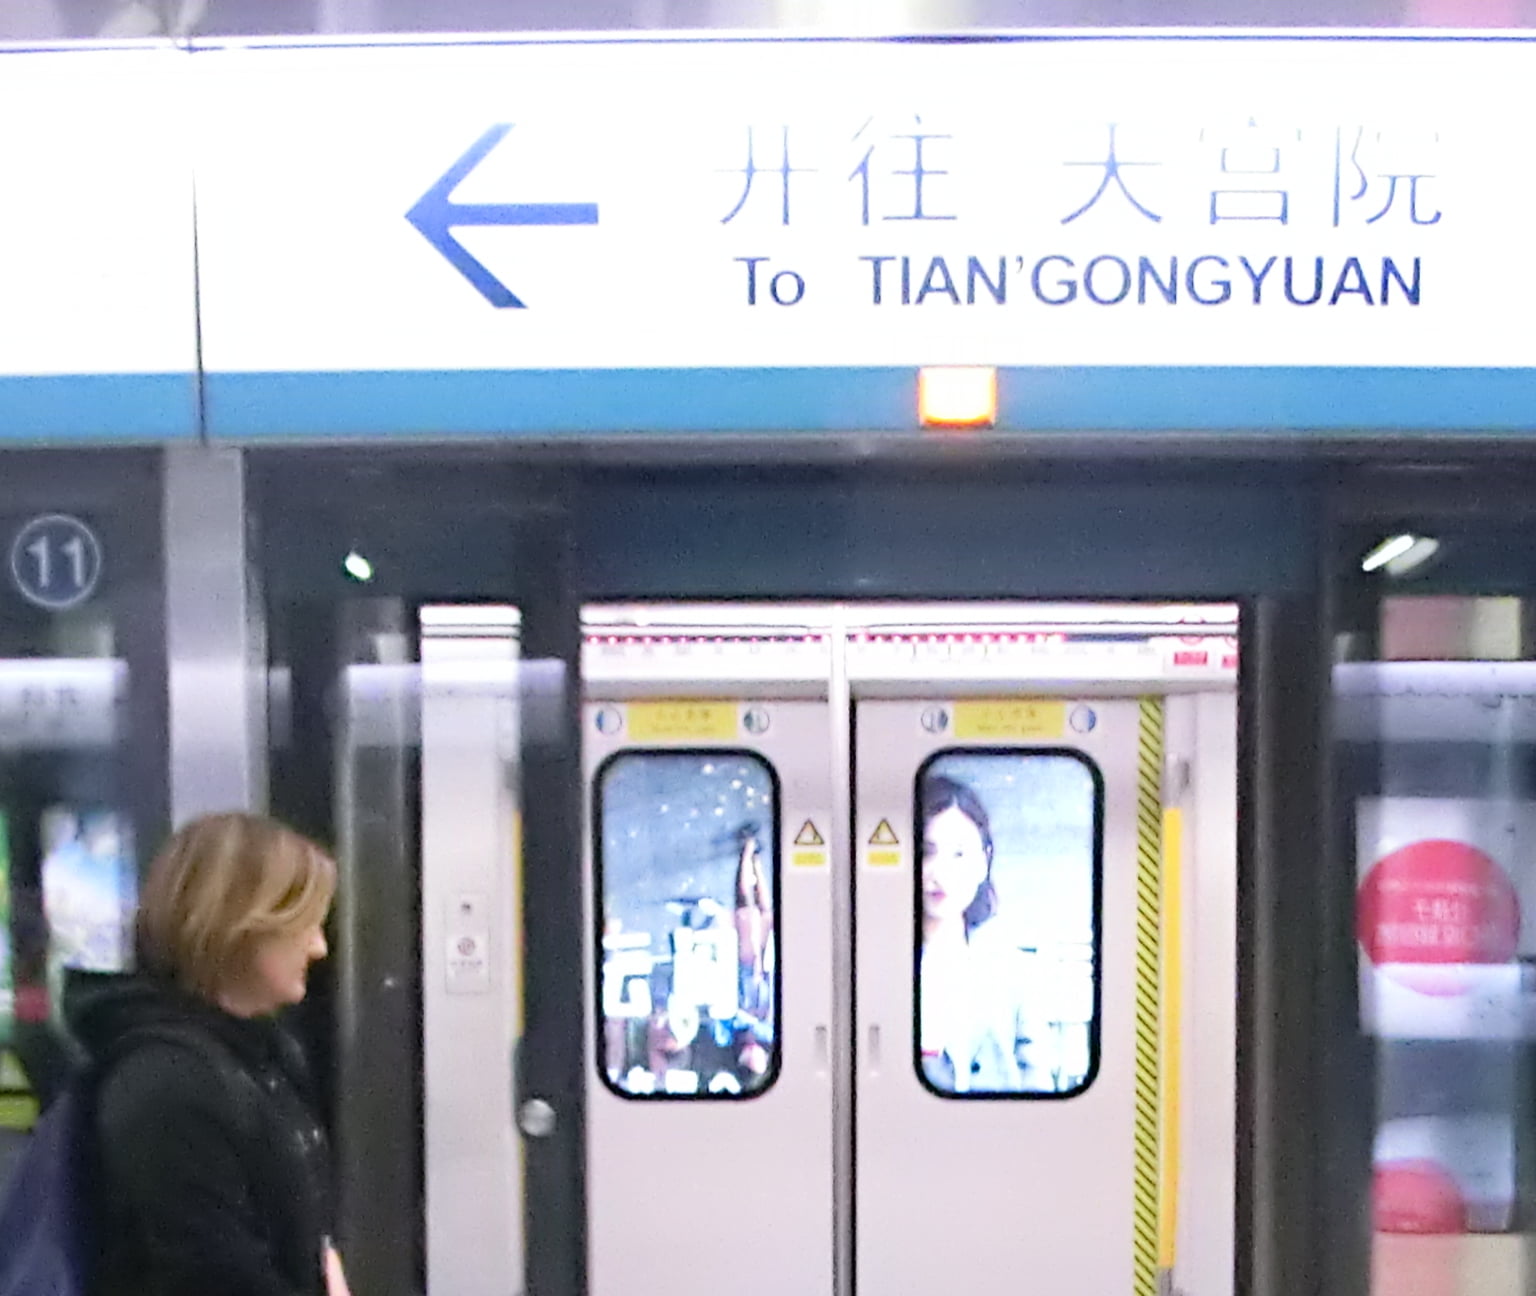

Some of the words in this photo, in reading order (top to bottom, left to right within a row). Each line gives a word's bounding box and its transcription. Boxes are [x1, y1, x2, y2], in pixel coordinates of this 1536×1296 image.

[732, 255, 807, 307] To
[857, 253, 1423, 308] TIAN'GONGYUAN
[25, 535, 83, 588] 11
